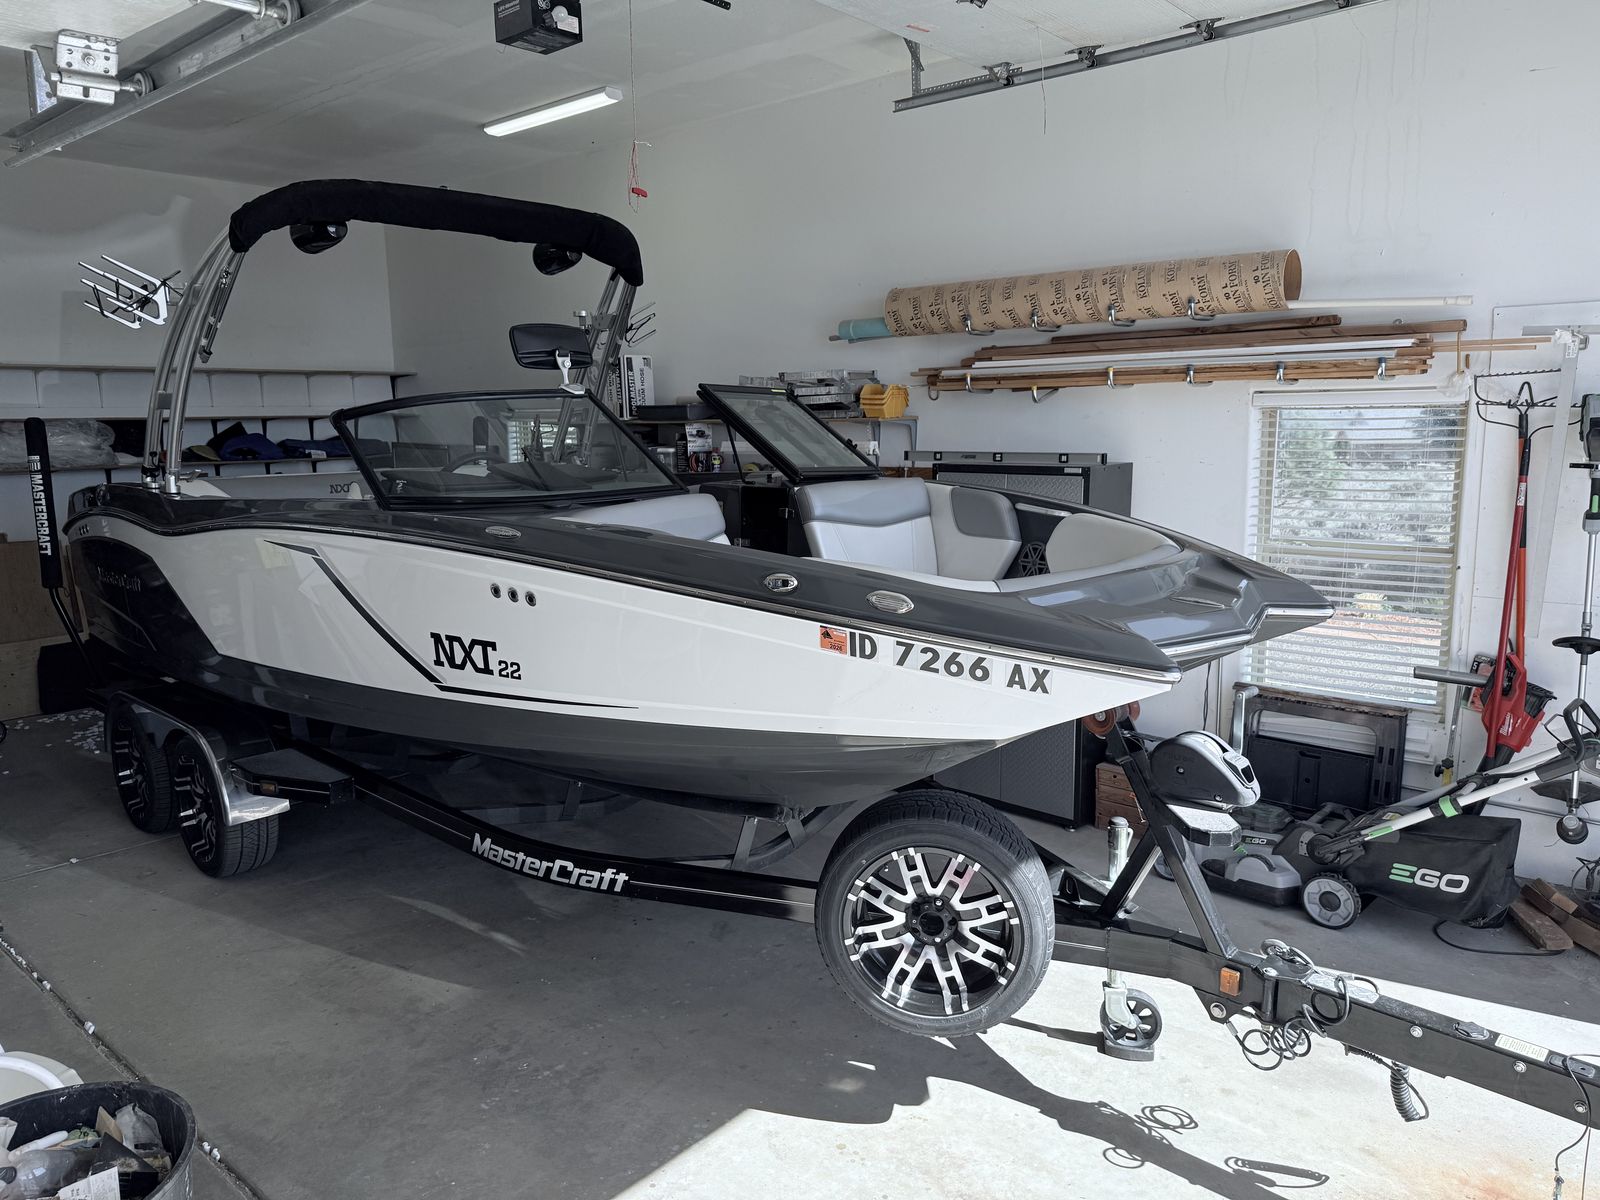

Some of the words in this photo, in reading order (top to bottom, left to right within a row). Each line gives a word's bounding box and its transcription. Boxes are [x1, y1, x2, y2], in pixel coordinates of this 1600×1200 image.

[1196, 274, 1210, 304] FORM
[1227, 260, 1238, 289] FORM
[1253, 274, 1261, 284] 10
[1075, 293, 1083, 302] 10
[1223, 292, 1231, 301] 10
[1261, 272, 1281, 309] KOLUMN
[30, 474, 52, 556] MASTERCRAFT
[430, 631, 497, 676] NXT
[498, 660, 522, 680] 22
[849, 631, 878, 660] ID
[895, 640, 990, 682] 7266
[1006, 663, 1050, 695] AX
[1246, 837, 1267, 845] EGO
[472, 832, 629, 892] MasterCraft
[1389, 863, 1470, 893] EGO
